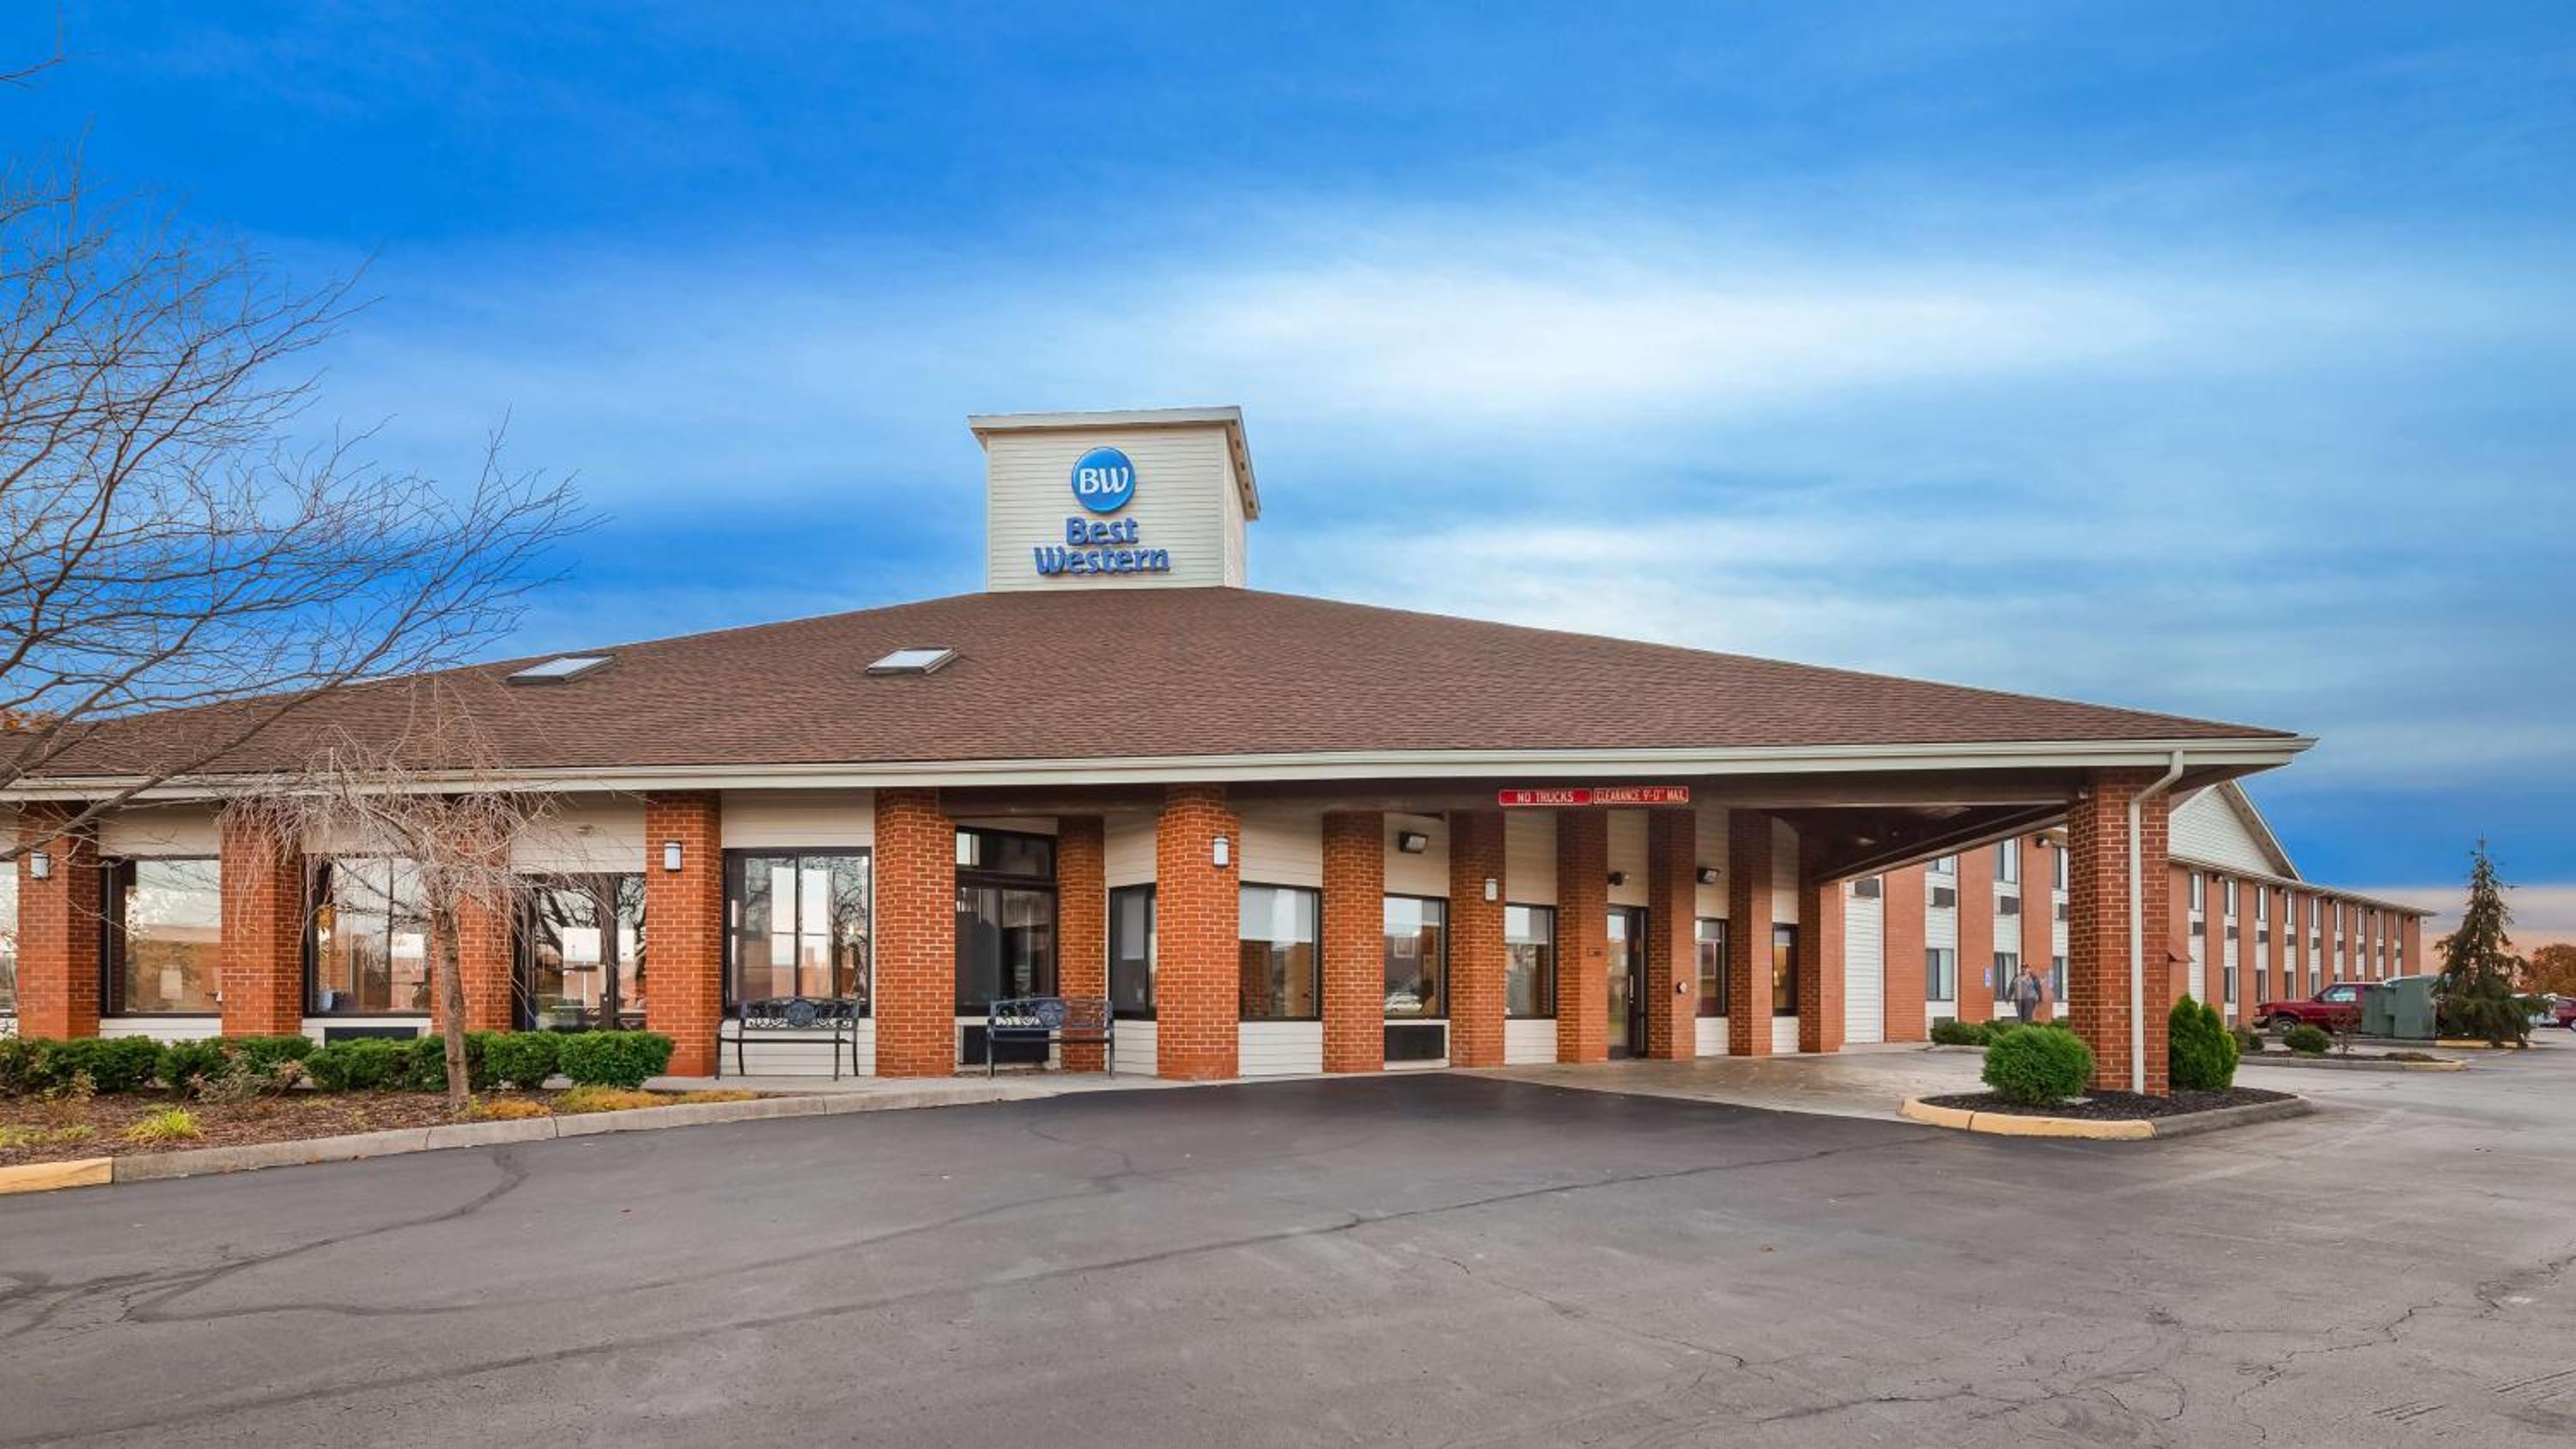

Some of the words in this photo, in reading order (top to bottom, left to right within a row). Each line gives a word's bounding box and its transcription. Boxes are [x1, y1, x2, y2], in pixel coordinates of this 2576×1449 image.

[1079, 468, 1128, 494] BW
[1066, 517, 1139, 545] Best
[1034, 546, 1170, 576] Western
[1517, 791, 1531, 803] NO
[1535, 791, 1574, 803] TRUCKS
[1597, 791, 1640, 802] CLEARANCE
